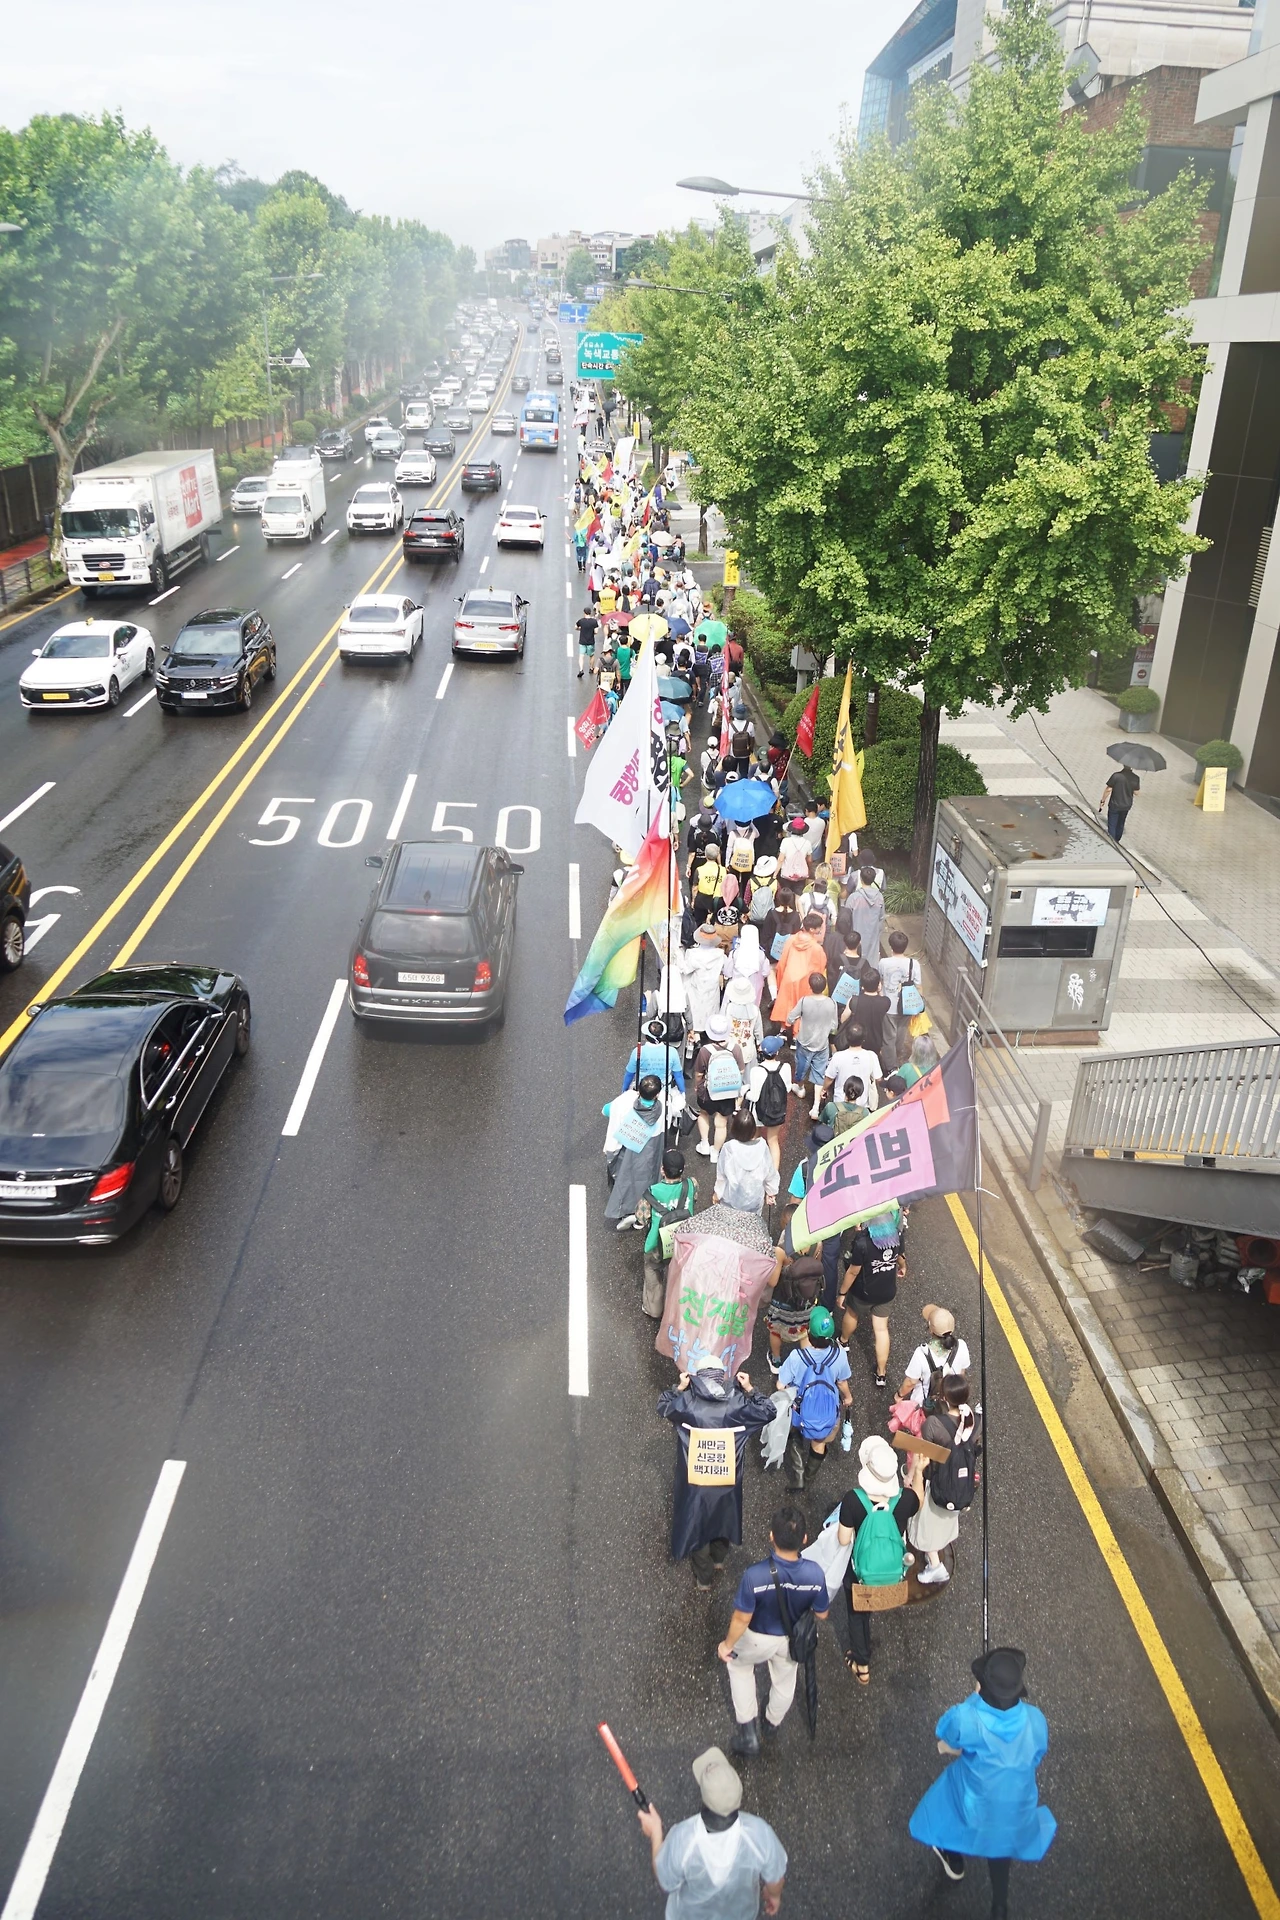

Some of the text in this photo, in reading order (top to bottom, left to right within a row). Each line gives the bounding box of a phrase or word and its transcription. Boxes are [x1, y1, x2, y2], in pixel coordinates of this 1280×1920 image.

[248, 797, 373, 848] 50
[697, 1440, 726, 1450] 새만금
[697, 1452, 726, 1463] 신공항
[693, 1464, 729, 1476] 백지화!!
